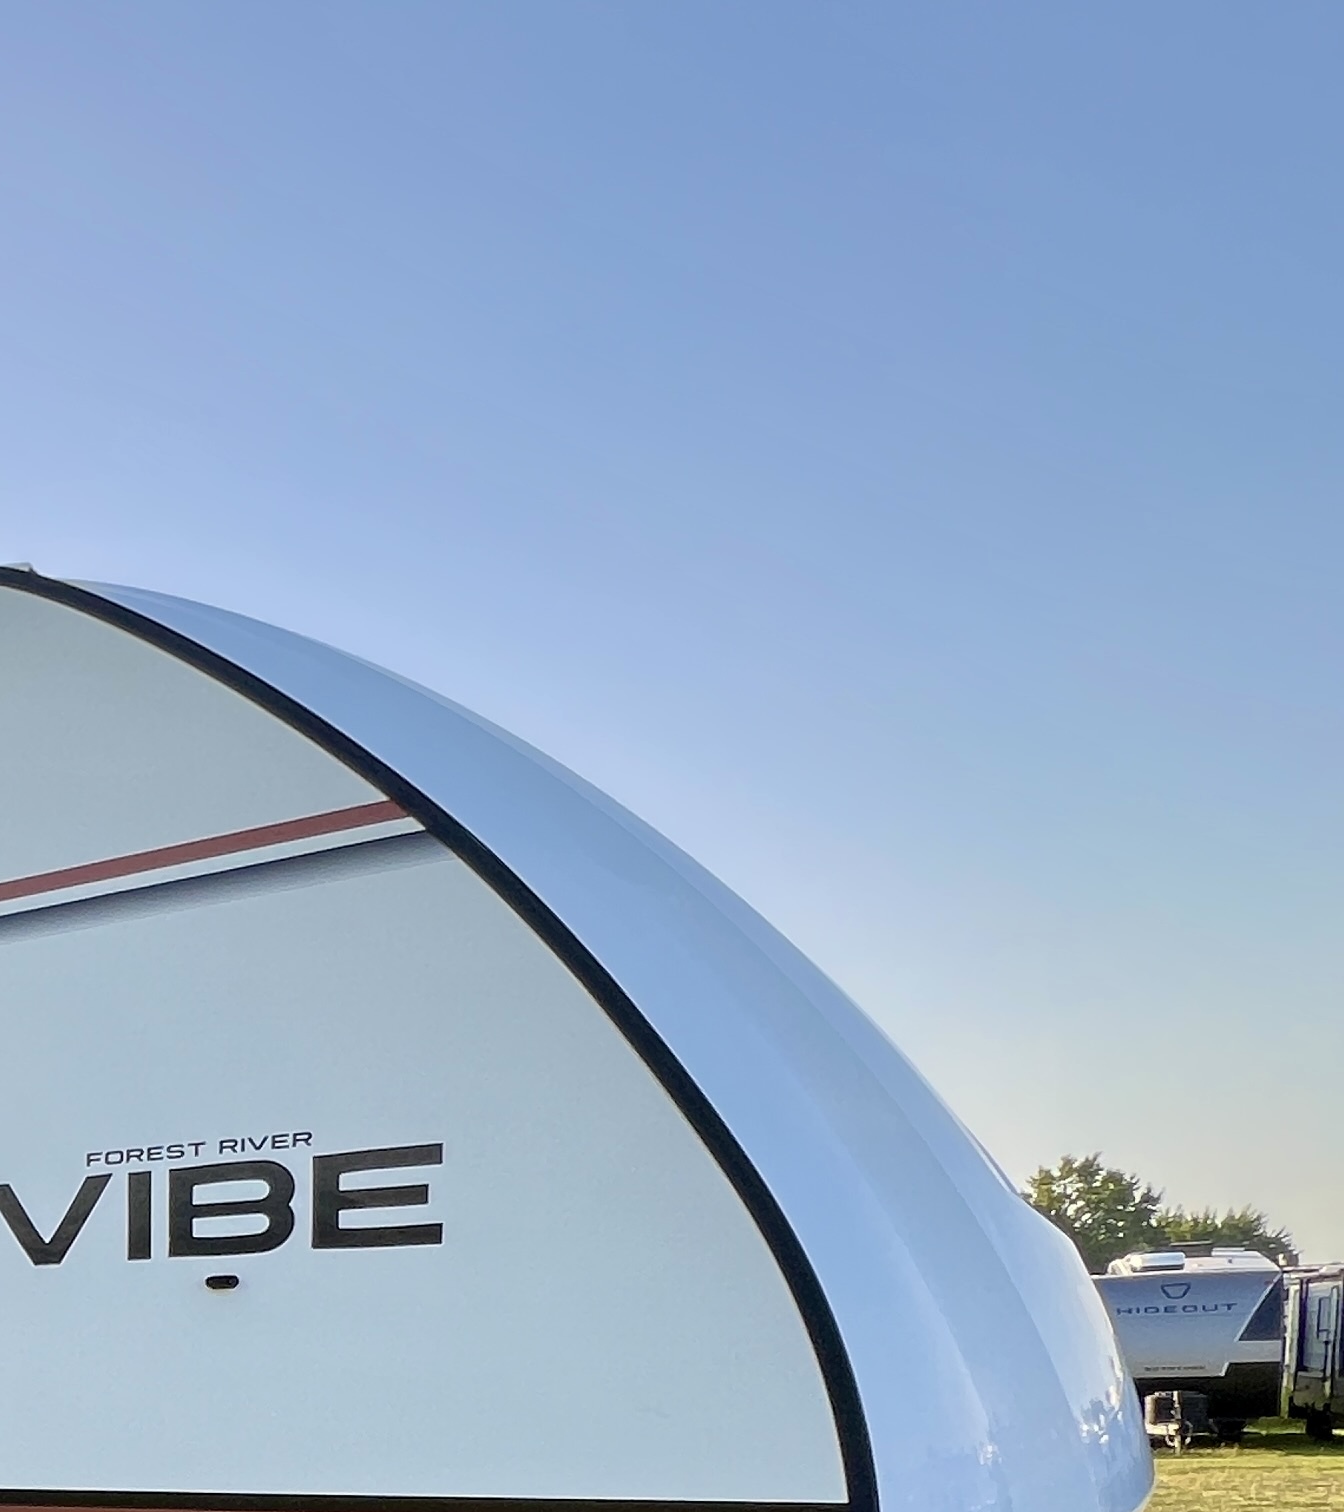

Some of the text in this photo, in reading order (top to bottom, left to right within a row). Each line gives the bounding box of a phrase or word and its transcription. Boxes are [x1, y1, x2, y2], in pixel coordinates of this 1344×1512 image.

[86, 1131, 313, 1167] FOREST RIVER
[1116, 1303, 1238, 1315] HIDEOUT
